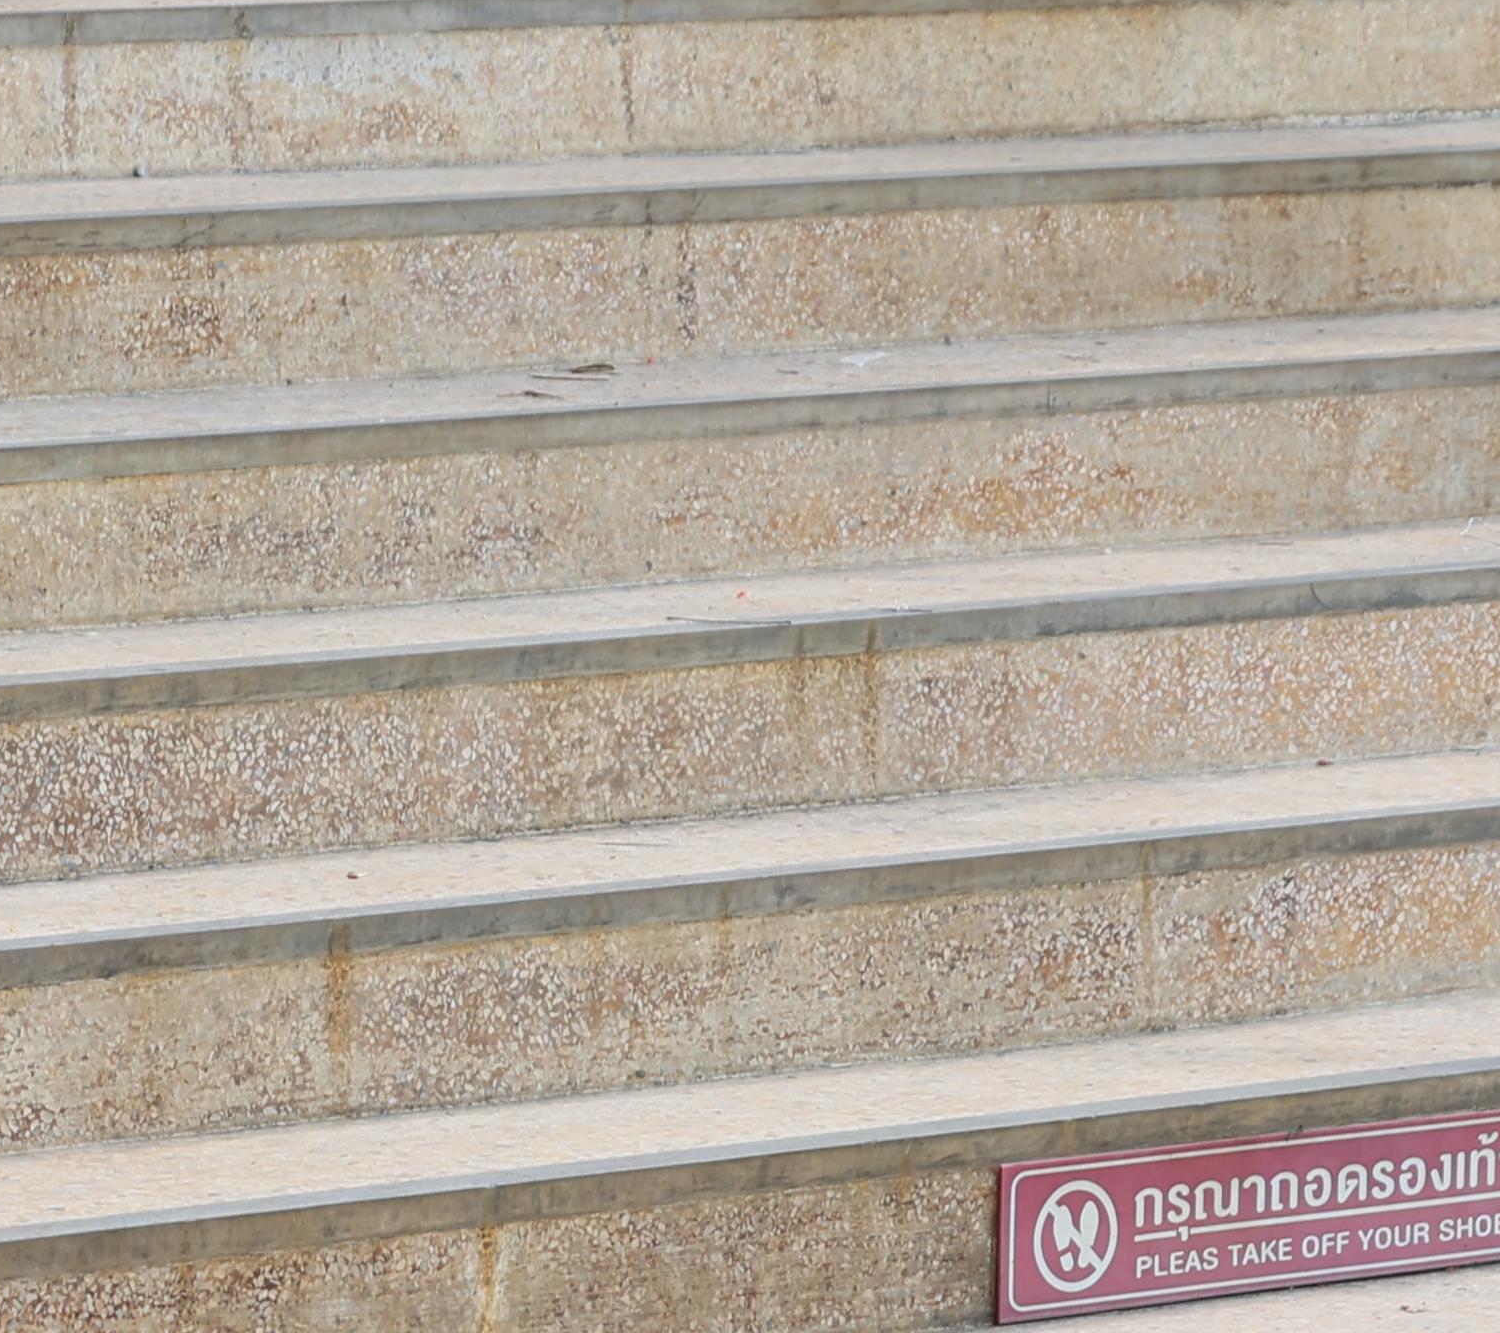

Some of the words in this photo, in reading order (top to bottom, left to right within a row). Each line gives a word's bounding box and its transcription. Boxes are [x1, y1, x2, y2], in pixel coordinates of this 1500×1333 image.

[1134, 1245, 1220, 1280] PLEAS
[1227, 1236, 1294, 1268] TAKE
[1300, 1229, 1352, 1260] OFF
[1356, 1220, 1431, 1252] YOUR
